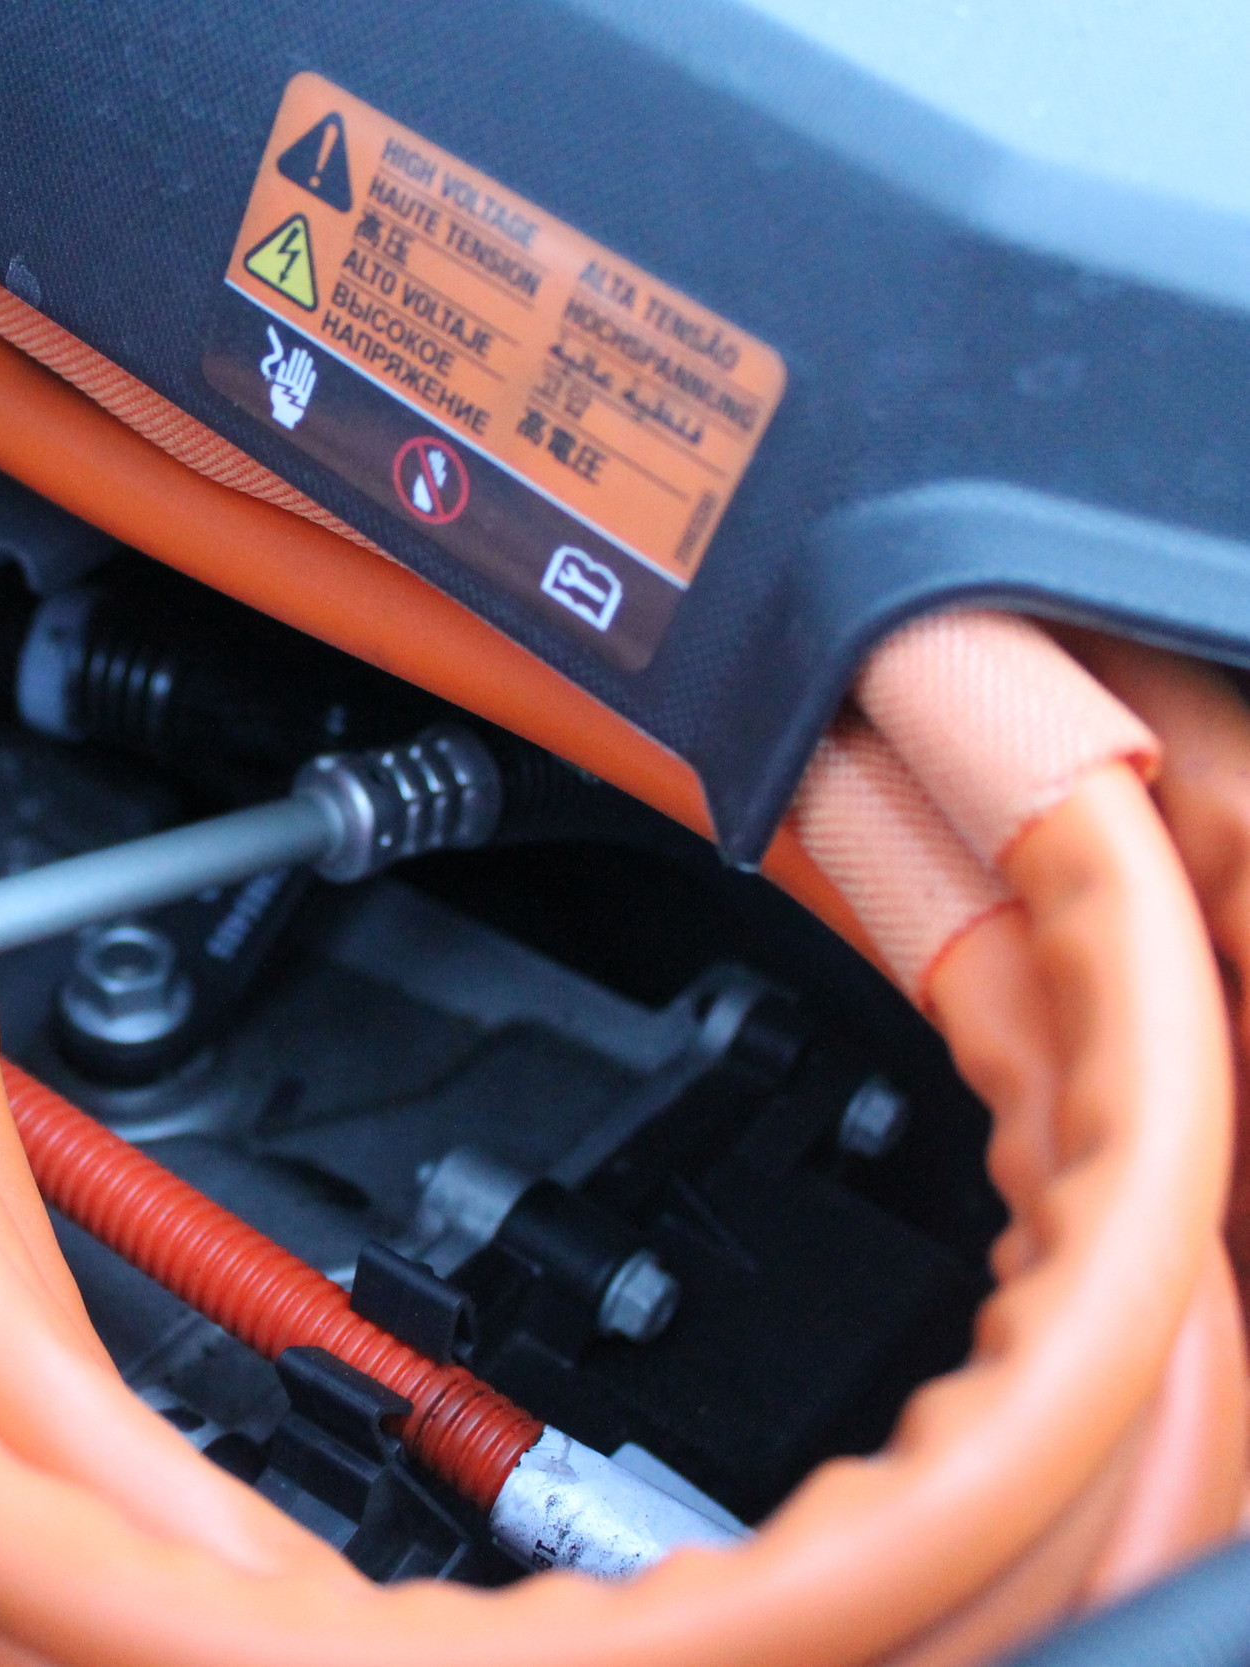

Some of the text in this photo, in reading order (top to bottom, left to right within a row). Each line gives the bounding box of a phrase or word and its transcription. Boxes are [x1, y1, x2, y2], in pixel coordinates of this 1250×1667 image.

[368, 174, 542, 298] HAUTE TENSION
[382, 138, 539, 250] HIGH VOLTAGE
[331, 281, 455, 378] ВЫСОКОЕ
[343, 249, 493, 358] ALTO VOLTAJE
[579, 261, 636, 311] ALTA
[321, 309, 492, 437] НАПРЯЖЕНИЕ
